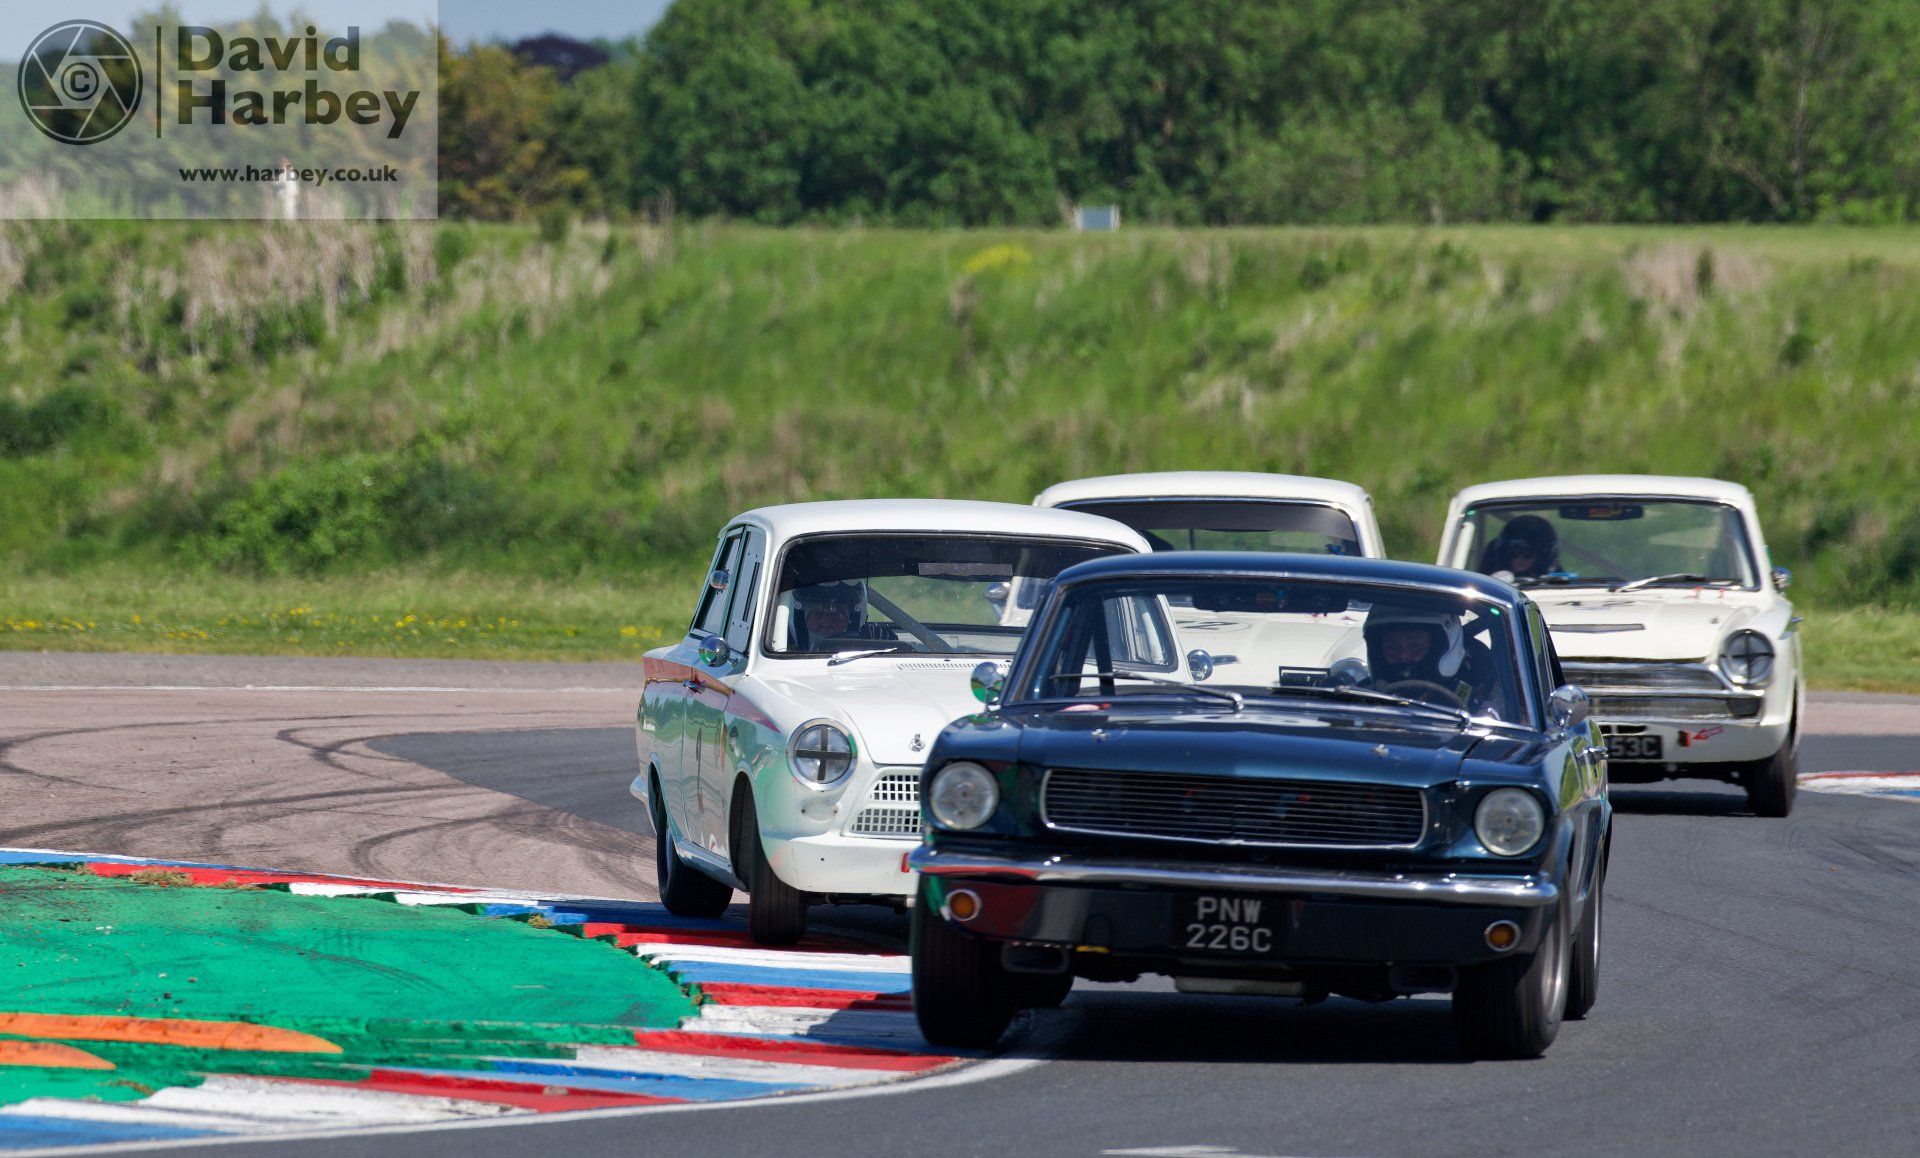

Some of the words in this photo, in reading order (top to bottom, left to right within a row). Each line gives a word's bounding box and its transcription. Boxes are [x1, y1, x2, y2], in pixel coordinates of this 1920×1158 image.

[1606, 736, 1658, 757] 53C
[1196, 896, 1262, 924] PNW
[1185, 923, 1272, 952] 226C
